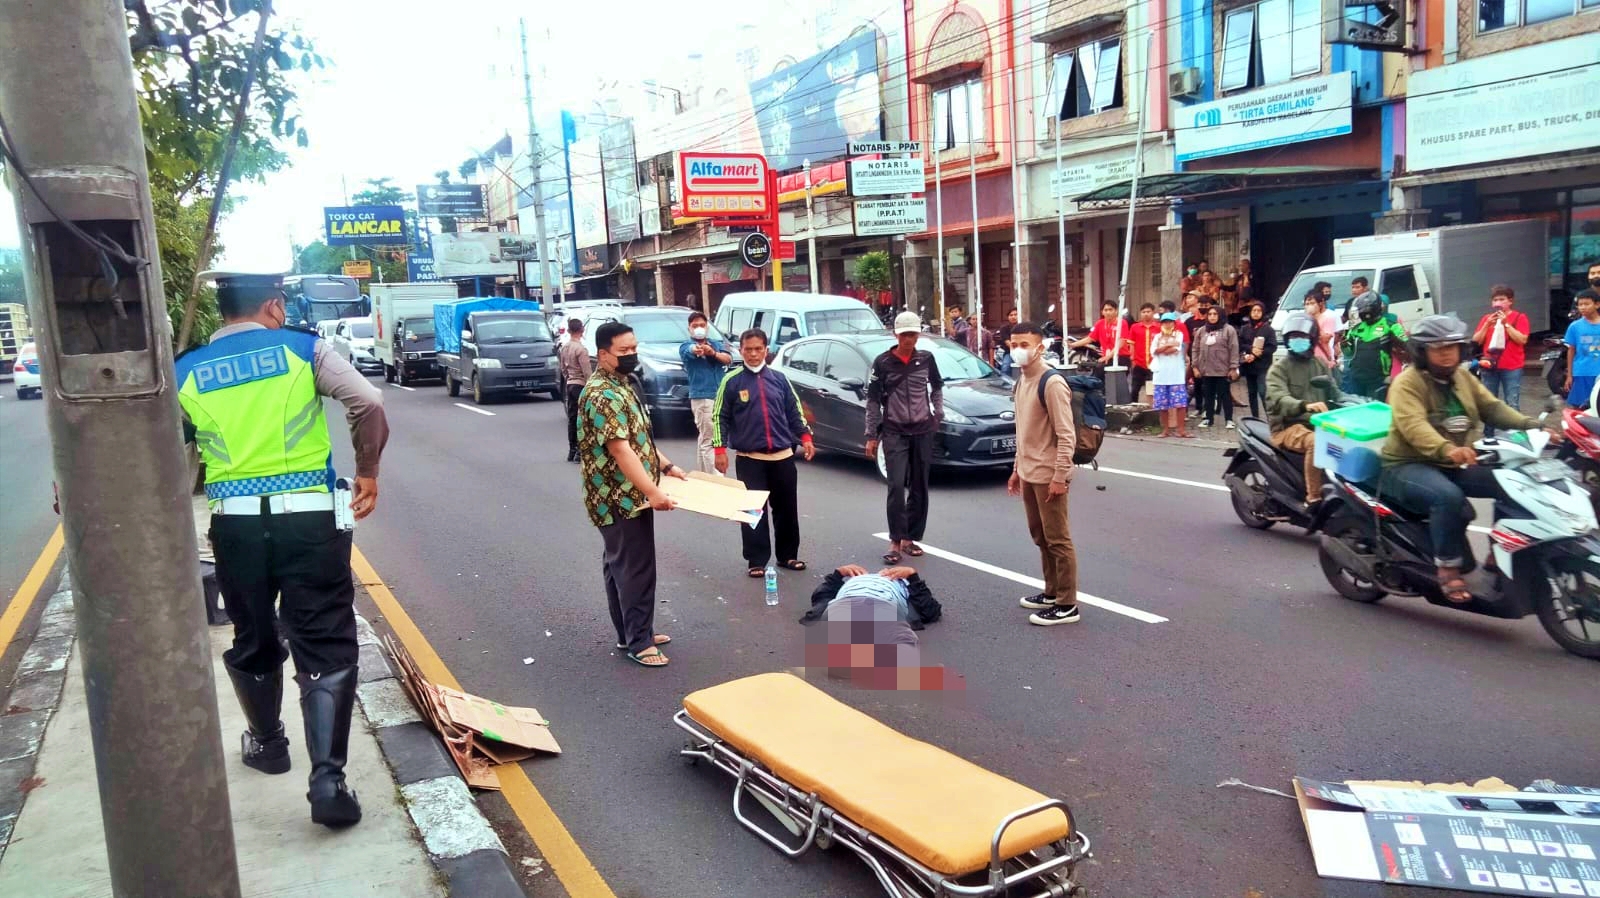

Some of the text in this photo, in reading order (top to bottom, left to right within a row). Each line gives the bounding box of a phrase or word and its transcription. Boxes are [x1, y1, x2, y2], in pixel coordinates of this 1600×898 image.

[1227, 84, 1328, 112] PERUSAHAAN DAERAH AIR MINUM
[1239, 107, 1265, 120] TIRTA
[1266, 96, 1315, 115] GEMILANG
[1420, 132, 1456, 146] KHUSUS
[1458, 128, 1487, 140] SPARE
[1489, 123, 1516, 136] PART,
[1543, 112, 1583, 127] TRUCK,
[853, 143, 891, 152] NOTARIS
[899, 142, 920, 151] PPAT
[691, 161, 759, 176] Alfamart
[868, 161, 909, 169] NOTARIS
[690, 199, 699, 207] 24
[328, 213, 356, 221] TOKO
[877, 209, 905, 218] (P.P.A.T)
[331, 220, 401, 234] LANCAR
[747, 244, 768, 255] bean!
[195, 349, 287, 390] POLISI
